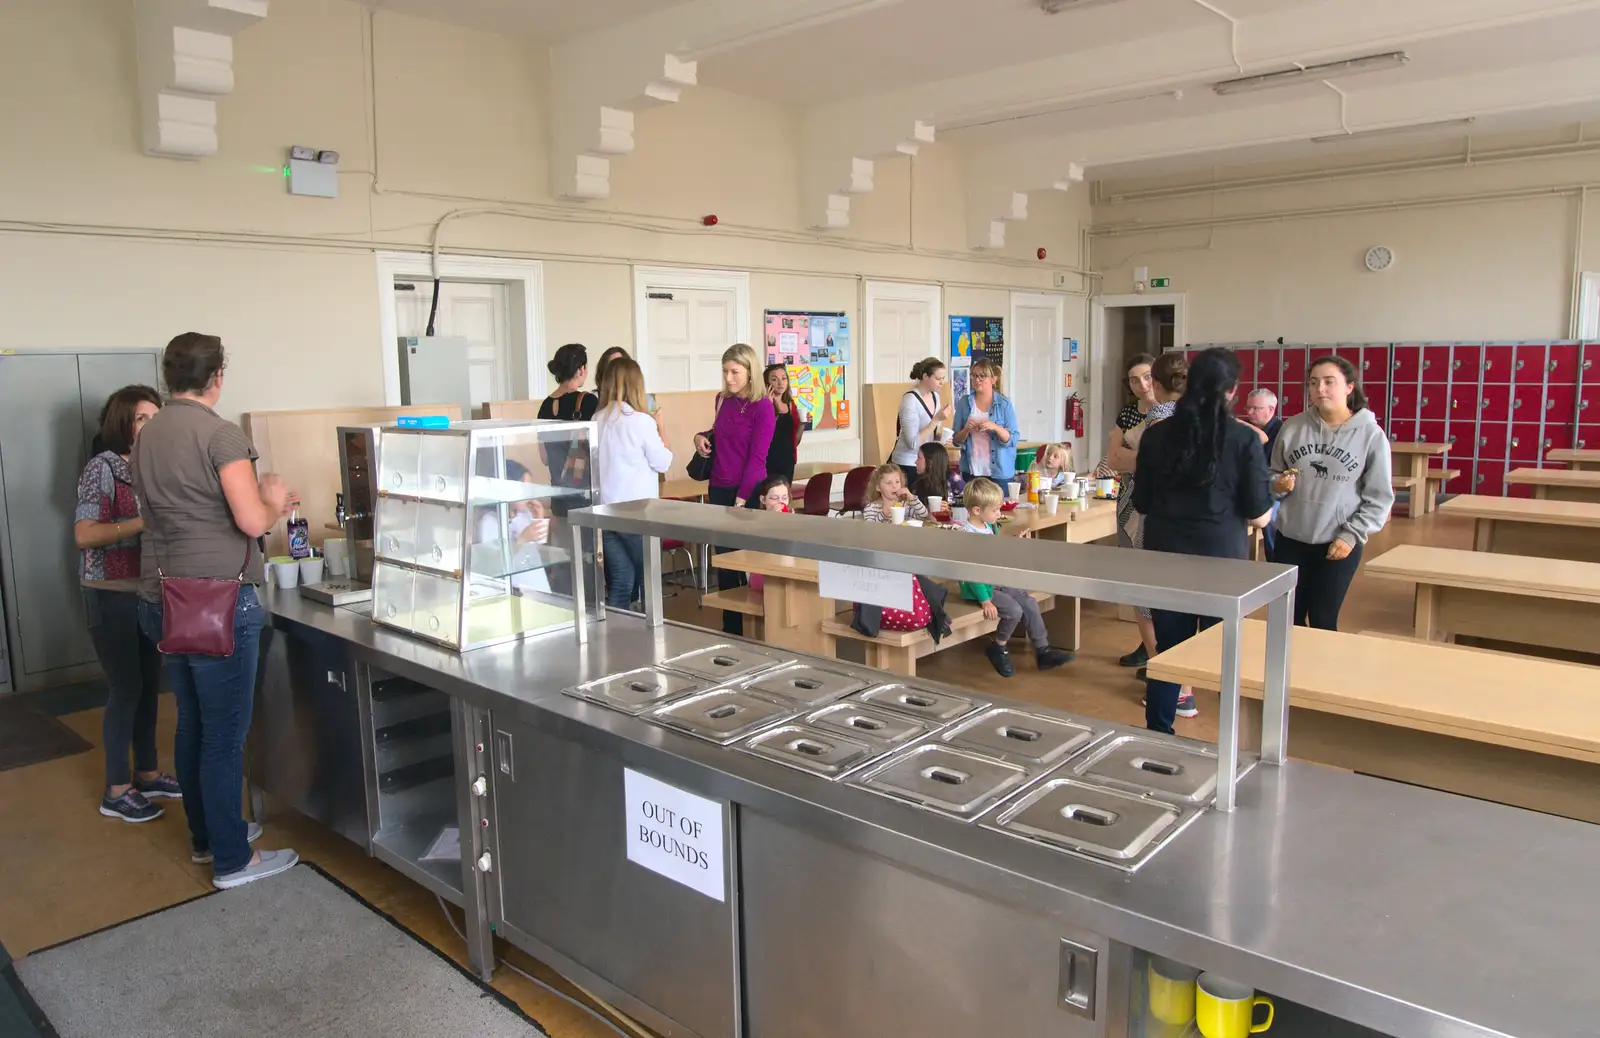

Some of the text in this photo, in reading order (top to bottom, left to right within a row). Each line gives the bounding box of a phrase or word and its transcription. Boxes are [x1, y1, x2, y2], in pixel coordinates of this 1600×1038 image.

[1332, 474, 1350, 482] 1892
[642, 800, 703, 839] OUT OF
[639, 824, 708, 870] BOUNDS
